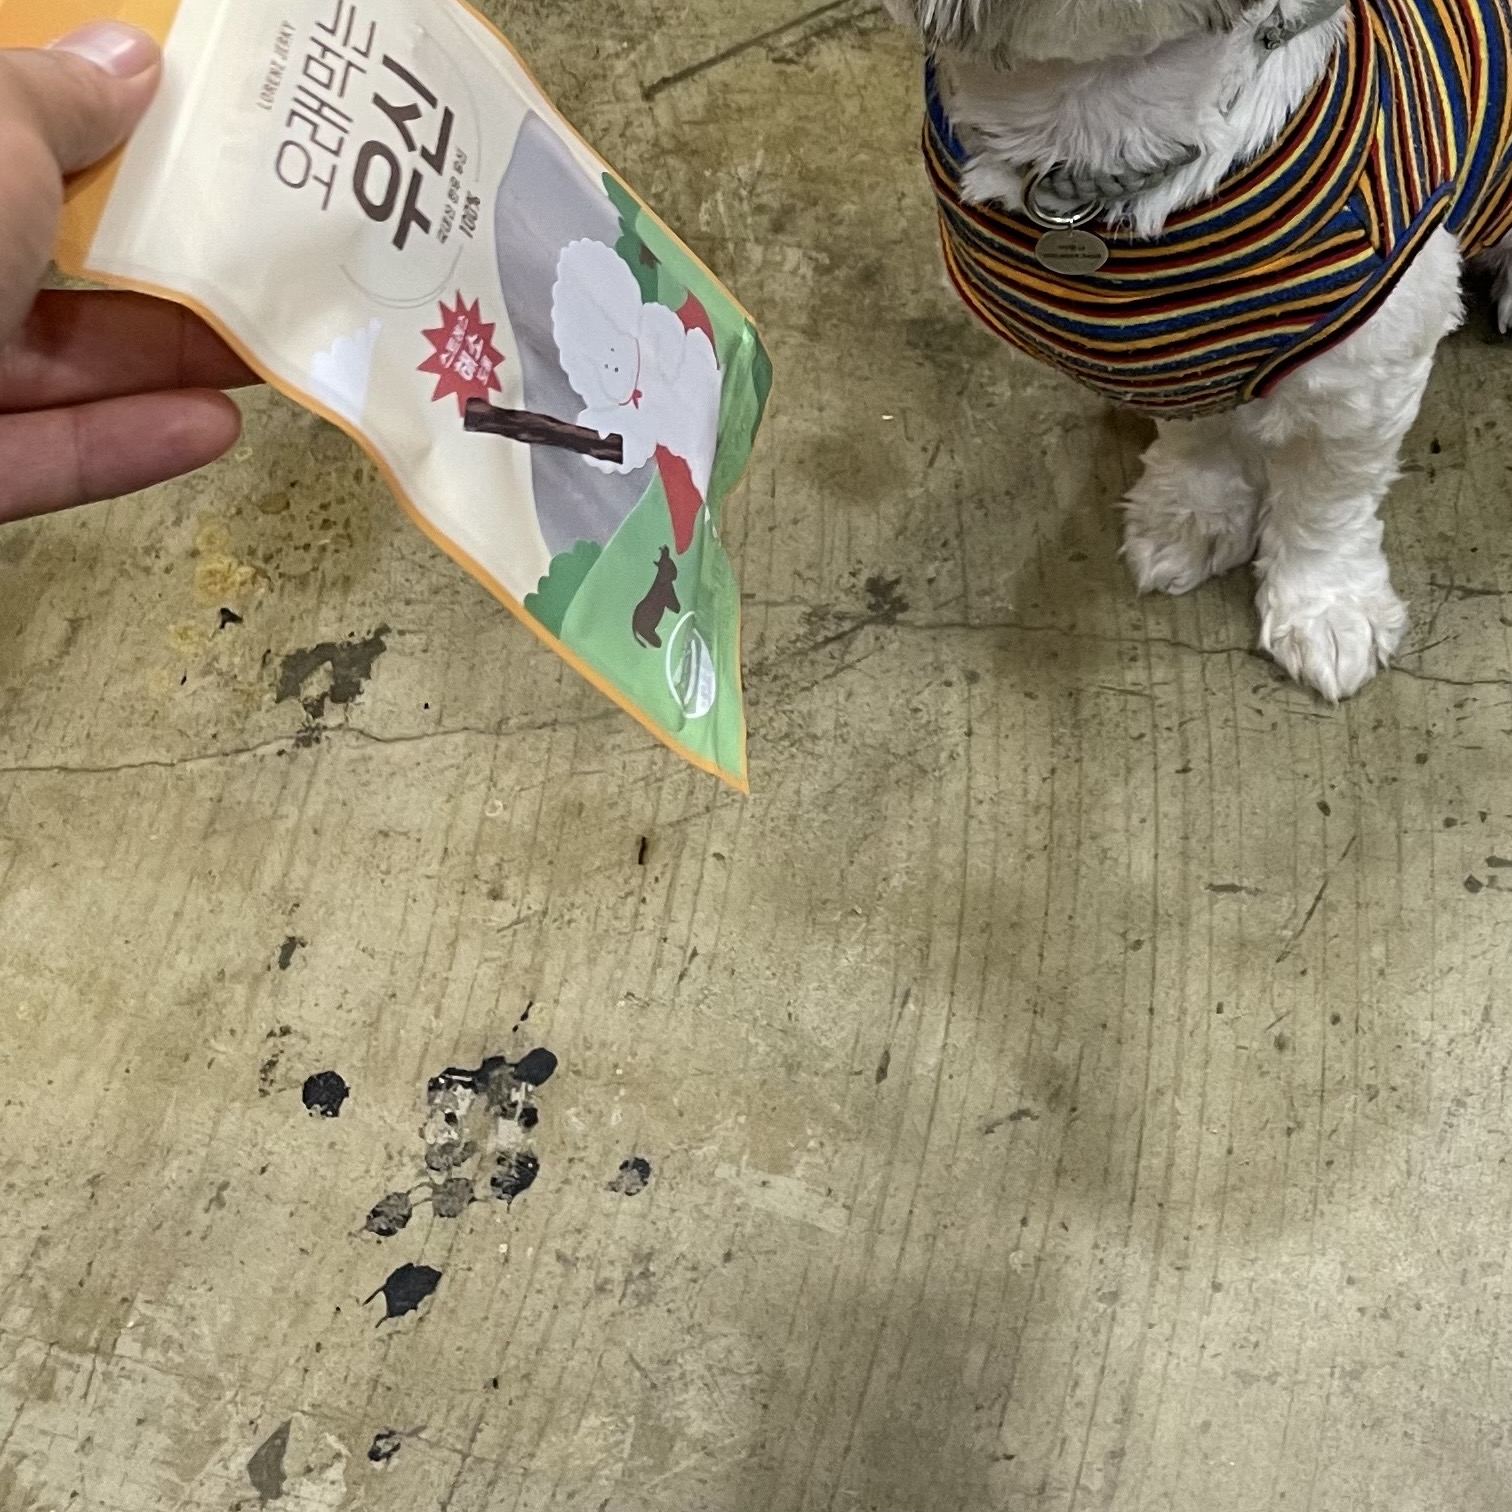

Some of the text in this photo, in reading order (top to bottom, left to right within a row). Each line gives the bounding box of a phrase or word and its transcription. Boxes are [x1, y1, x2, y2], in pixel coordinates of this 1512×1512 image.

[275, 0, 376, 211] 오래먹는
[353, 54, 455, 251] 우신
[458, 190, 481, 239] 100%
